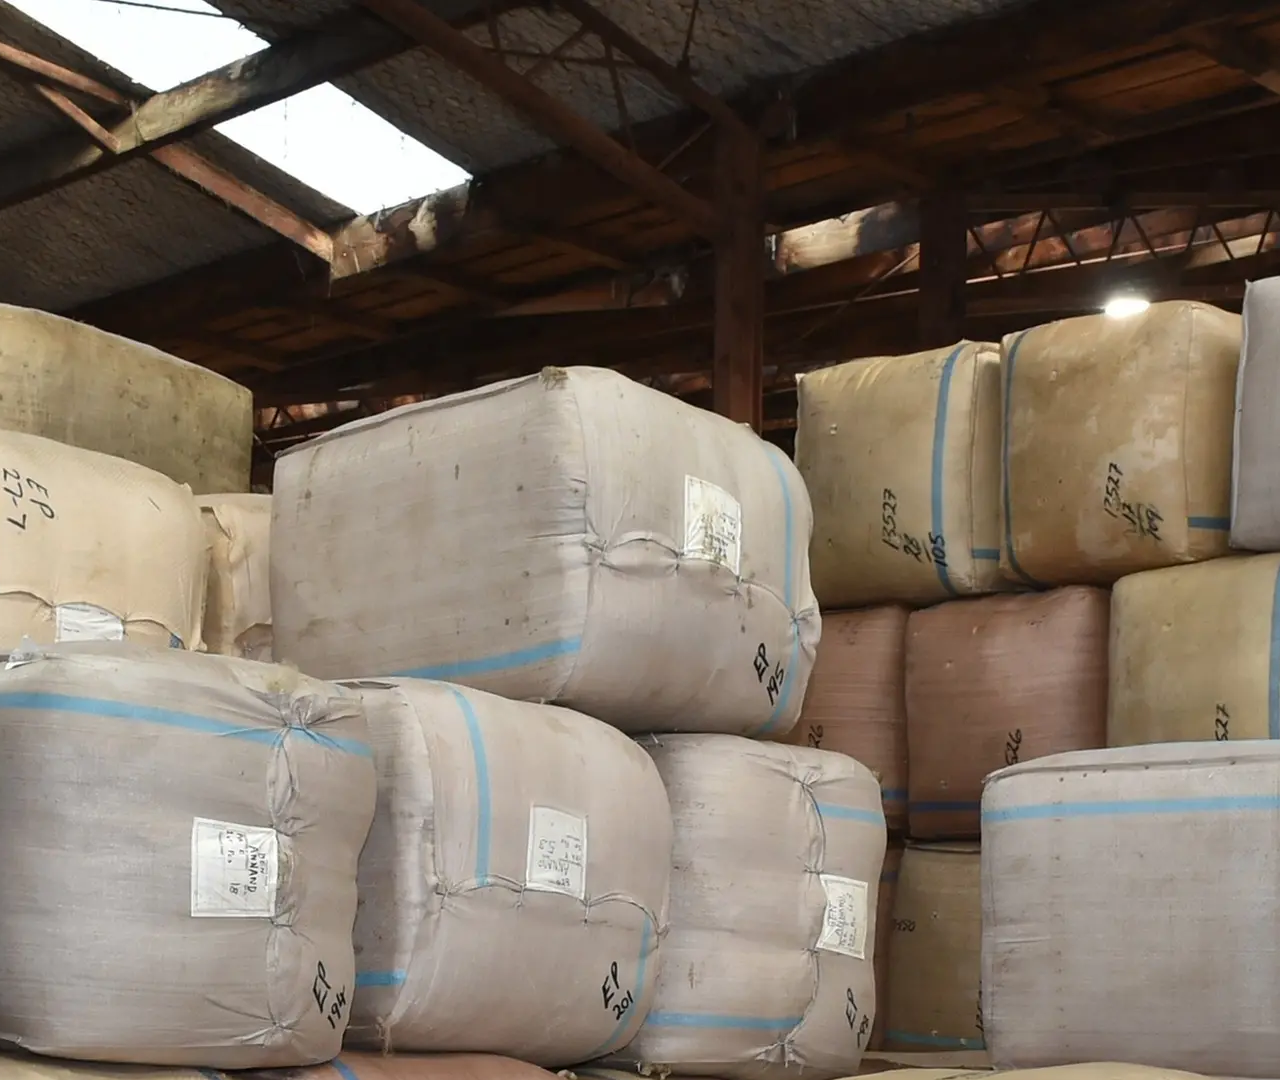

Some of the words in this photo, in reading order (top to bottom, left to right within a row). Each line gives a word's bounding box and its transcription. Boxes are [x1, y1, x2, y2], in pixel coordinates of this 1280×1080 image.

[26, 477, 55, 519] EP
[881, 488, 900, 550] 13527
[753, 642, 770, 684] EP
[766, 660, 785, 707] 195
[248, 845, 260, 893] ANNAND
[313, 960, 331, 1014] EP
[327, 985, 347, 1030] 194
[602, 961, 620, 1010] EP
[612, 990, 634, 1021] 201
[845, 987, 858, 1030] EP
